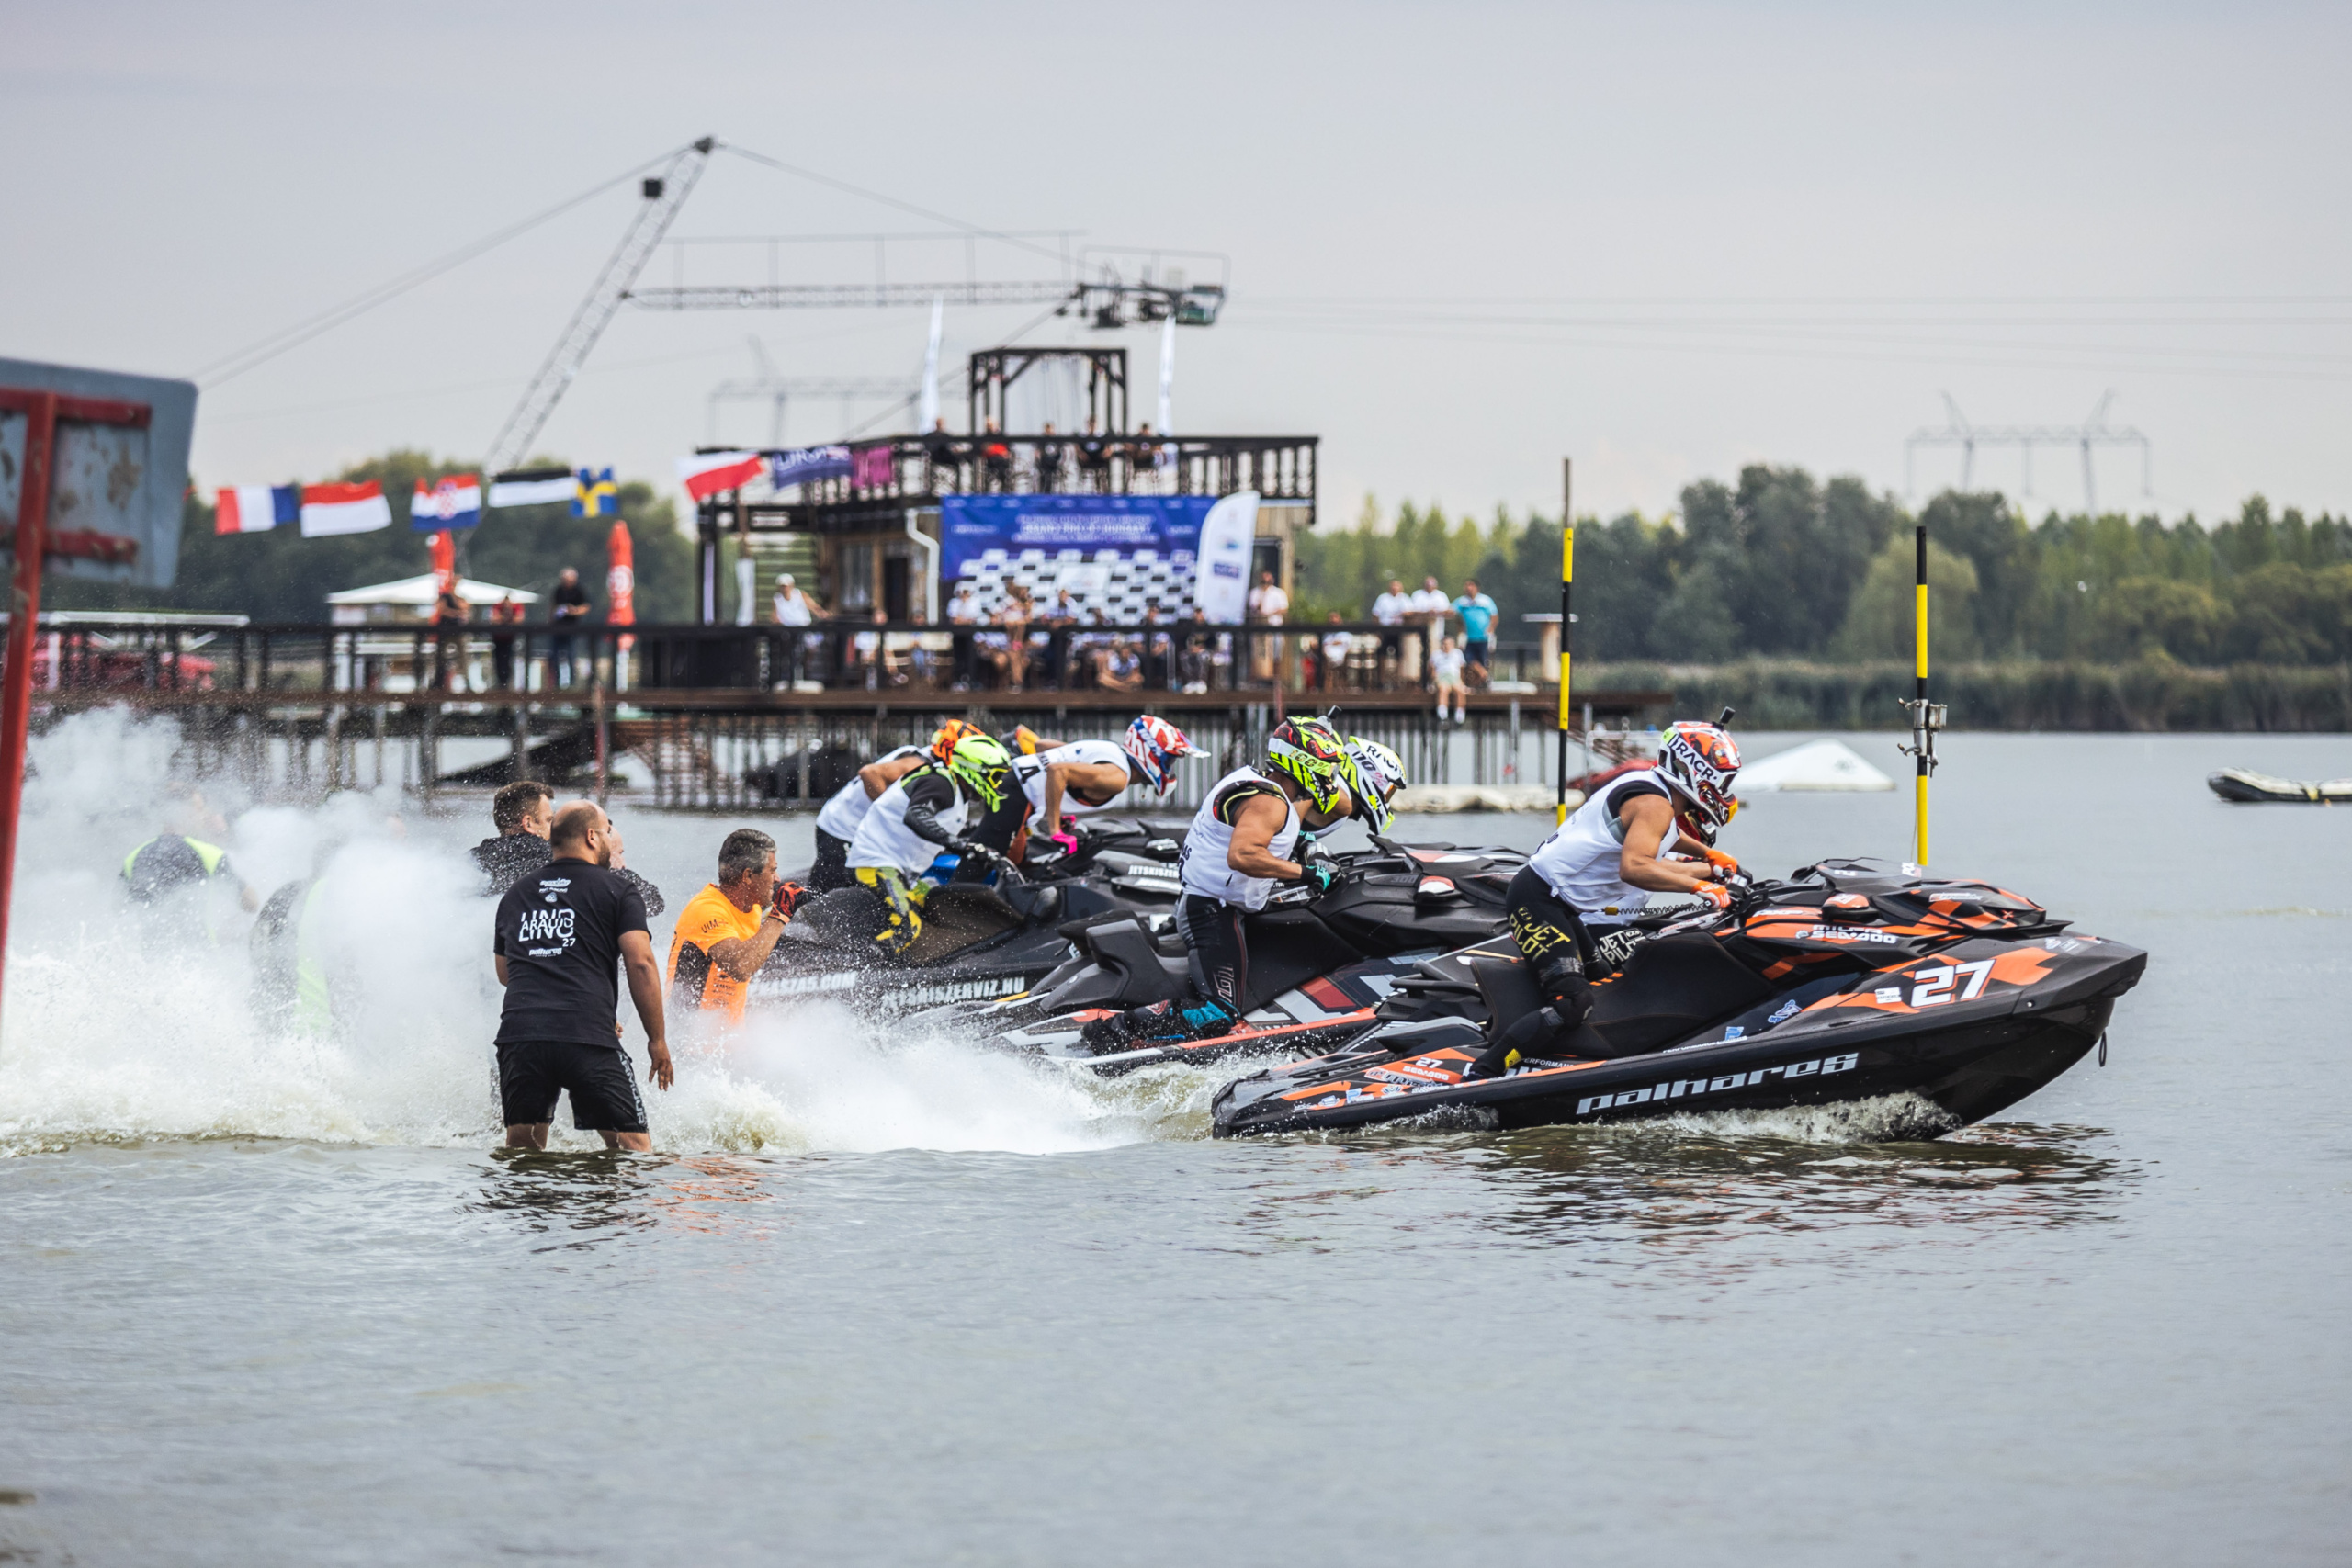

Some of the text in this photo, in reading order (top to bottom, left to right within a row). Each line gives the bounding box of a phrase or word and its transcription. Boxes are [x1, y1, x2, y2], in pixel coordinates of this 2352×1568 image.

[561, 937, 576, 948] 27
[1523, 920, 1572, 948] JET
[1599, 931, 1627, 953] JET
[1911, 958, 1996, 1008] 27
[1415, 1056, 1444, 1069] 27
[1576, 1052, 1860, 1115] palhares
